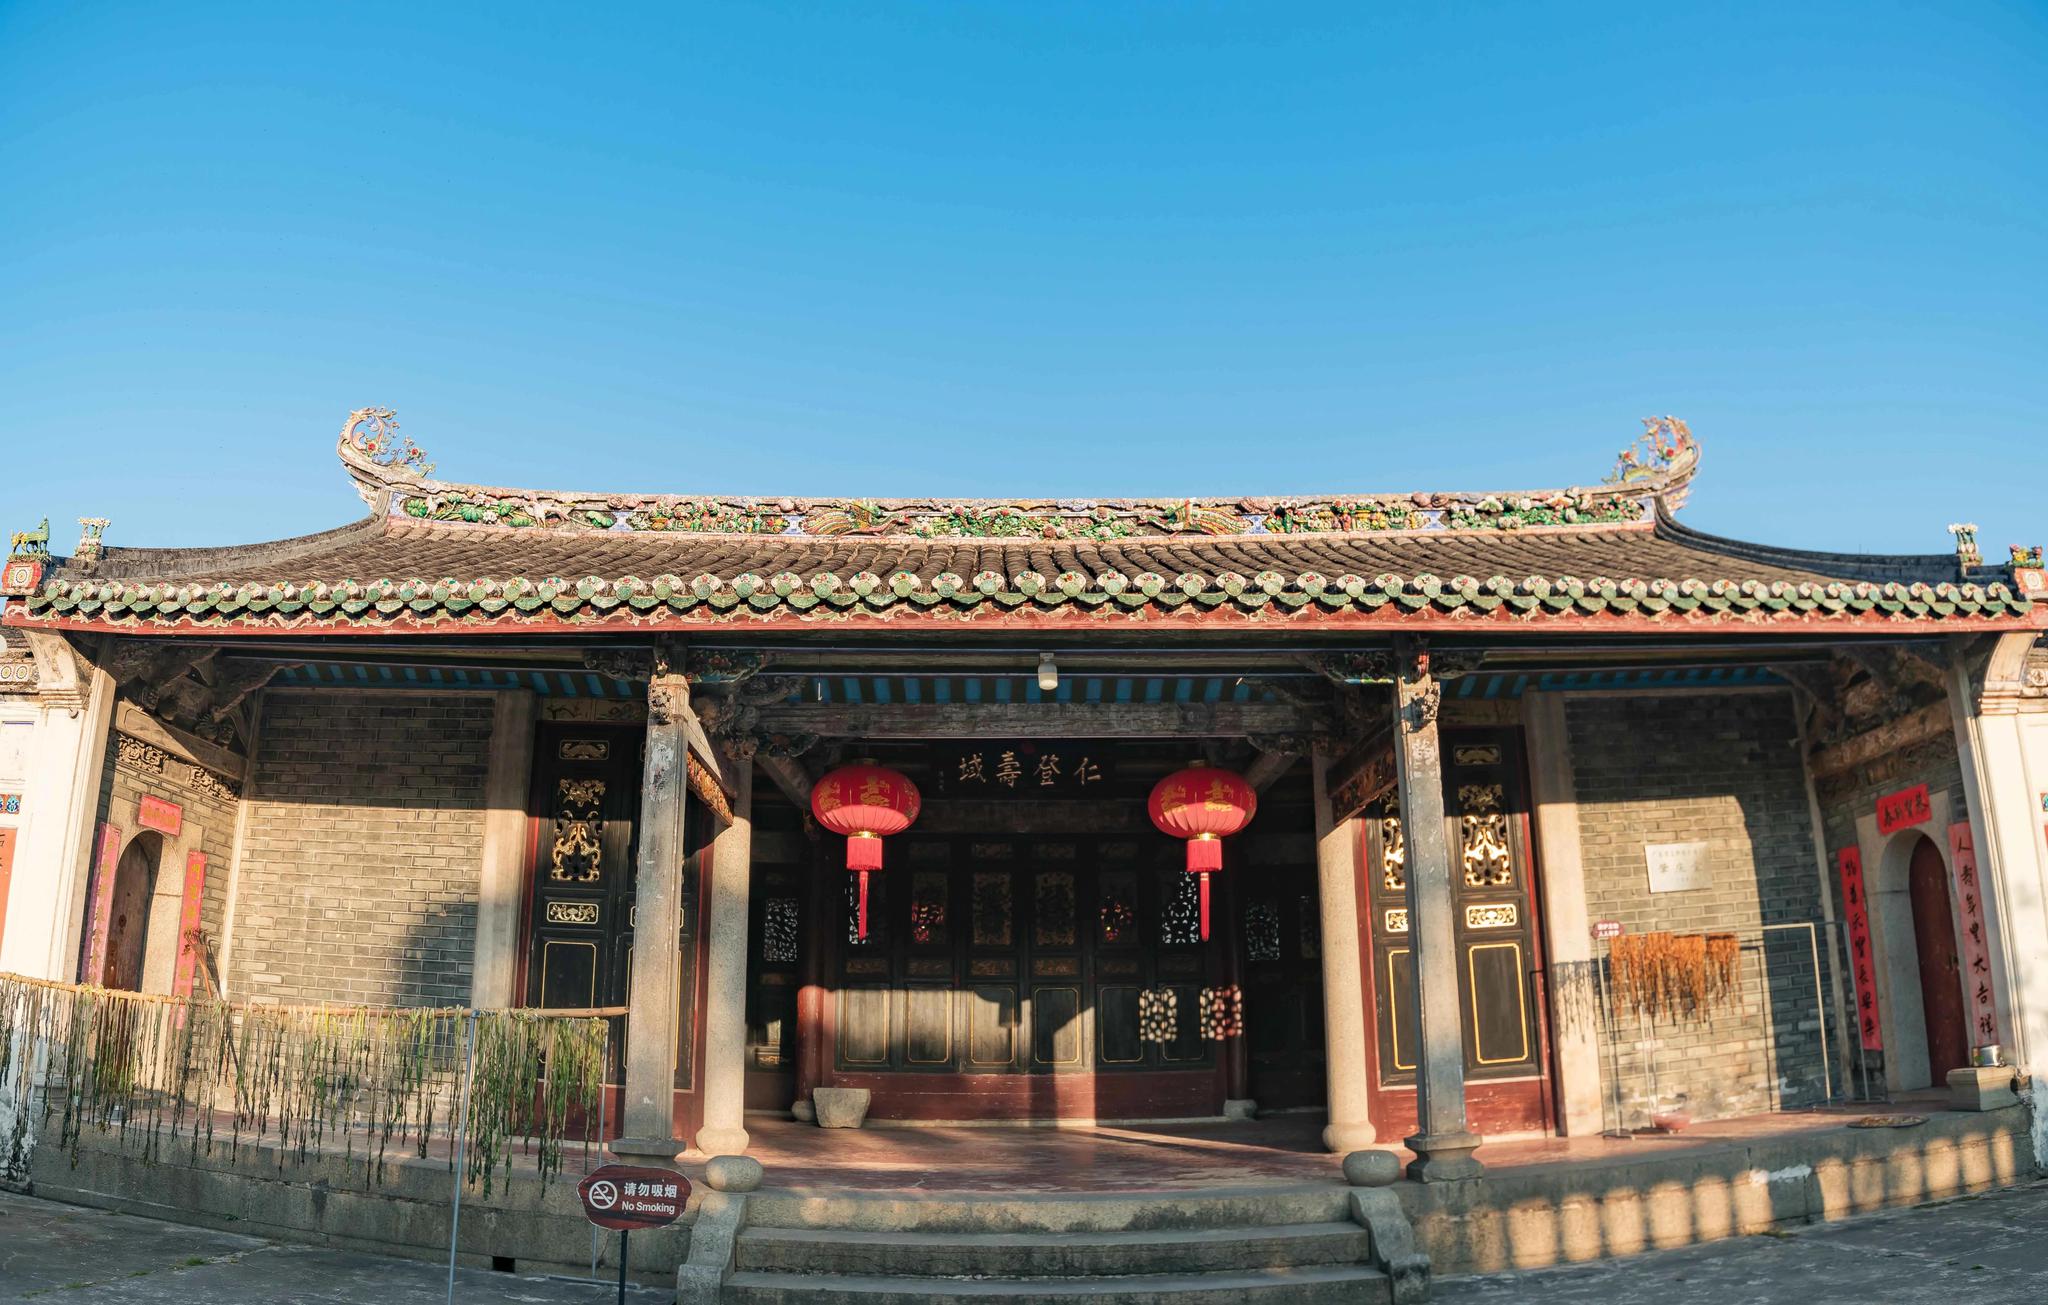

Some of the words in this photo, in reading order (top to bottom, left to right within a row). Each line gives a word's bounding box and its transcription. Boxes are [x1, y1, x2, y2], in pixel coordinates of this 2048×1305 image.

[624, 1182, 677, 1198] 请勿吸烟
[622, 1201, 634, 1211] No
[636, 1201, 675, 1214] Smoking
